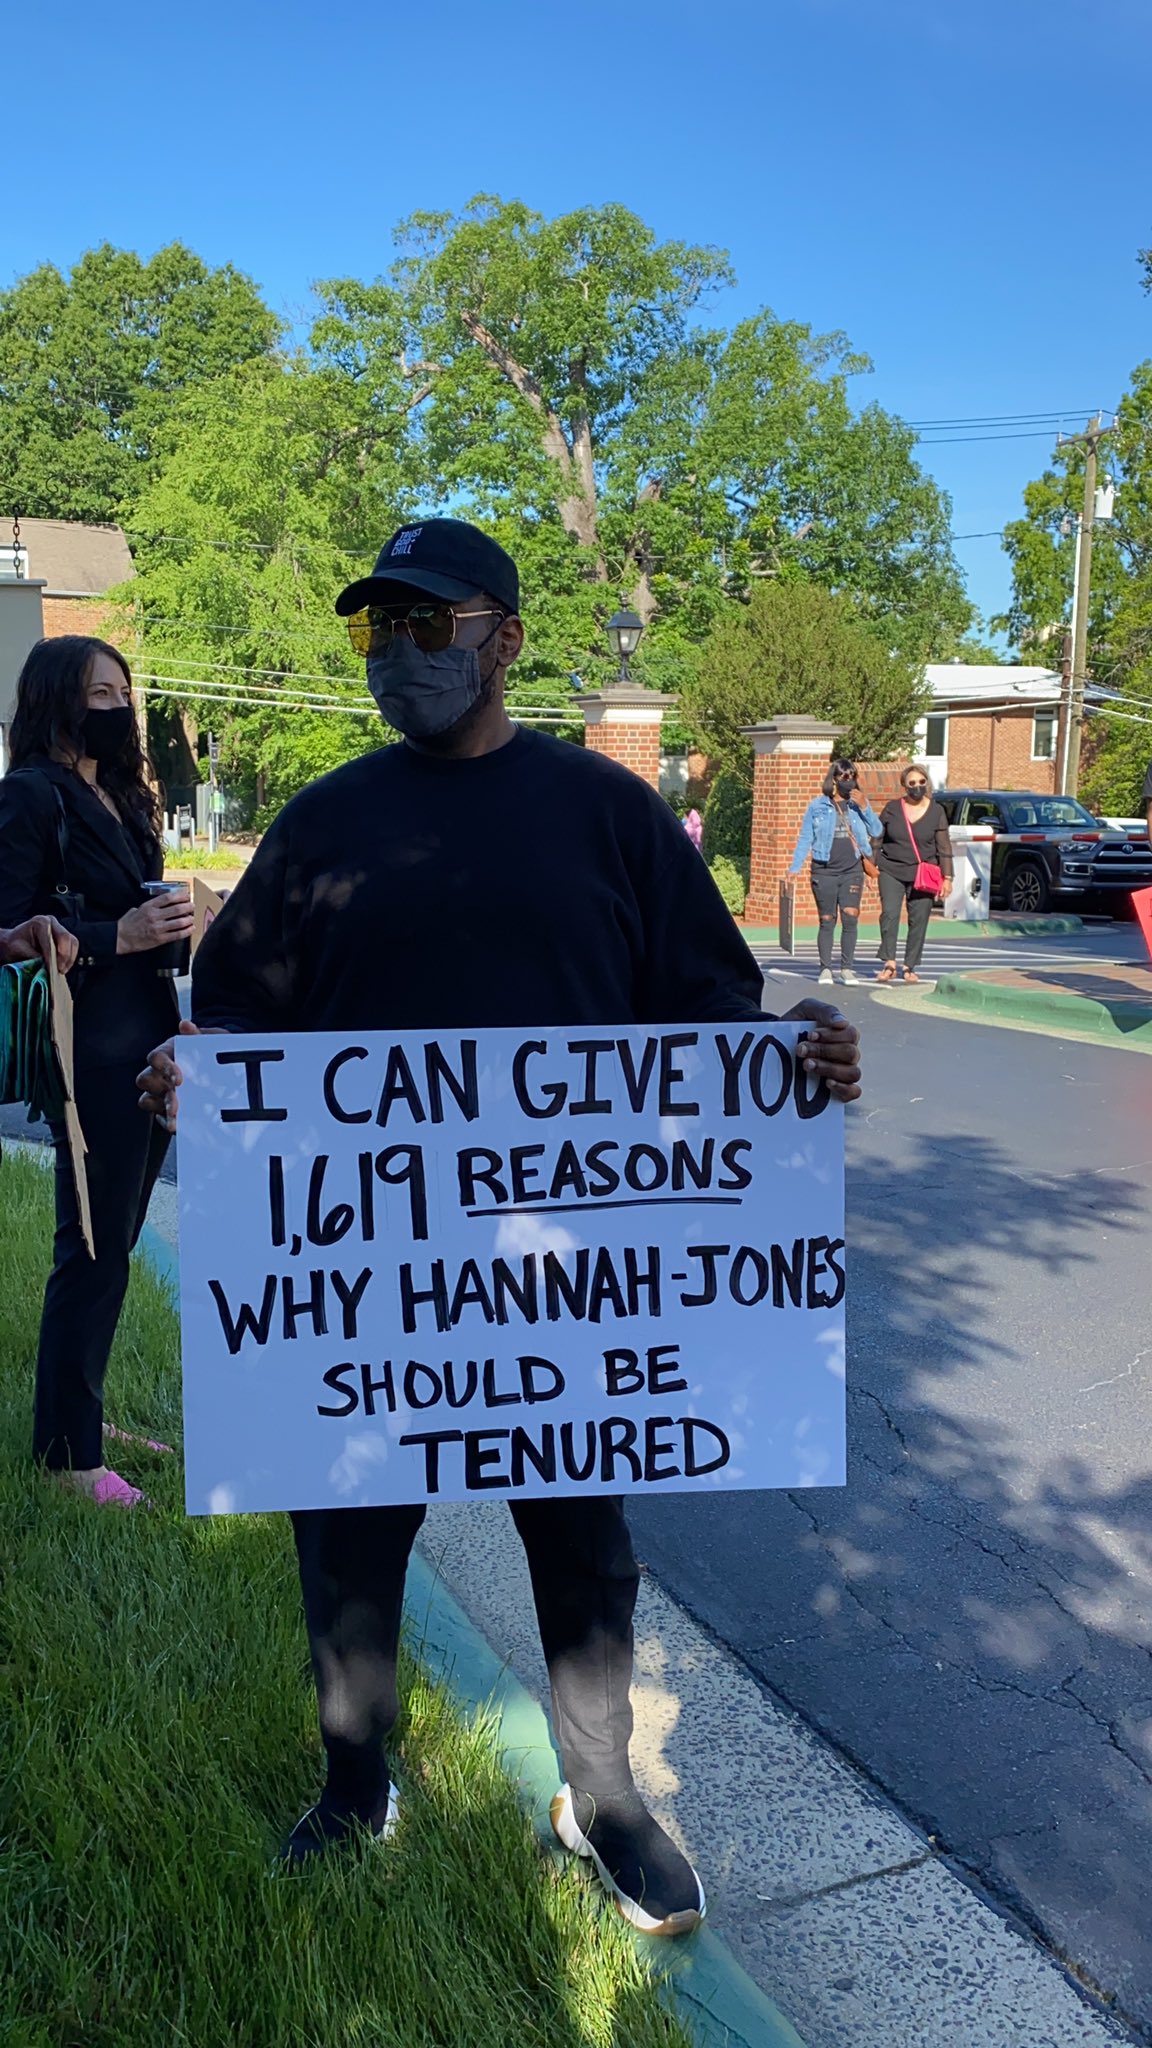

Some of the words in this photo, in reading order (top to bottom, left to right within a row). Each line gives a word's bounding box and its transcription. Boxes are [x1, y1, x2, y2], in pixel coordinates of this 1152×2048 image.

[216, 1049, 288, 1122] I
[323, 1039, 480, 1128] CAN
[513, 1032, 699, 1119] GIVE
[269, 1143, 429, 1257] 1,619
[457, 1138, 753, 1207] REASONS
[208, 1267, 373, 1354] WHY
[399, 1235, 846, 1334] HANNAH-JONES
[317, 1355, 566, 1417] SHOULD
[602, 1344, 688, 1397] BE
[399, 1416, 731, 1493] TENURED
